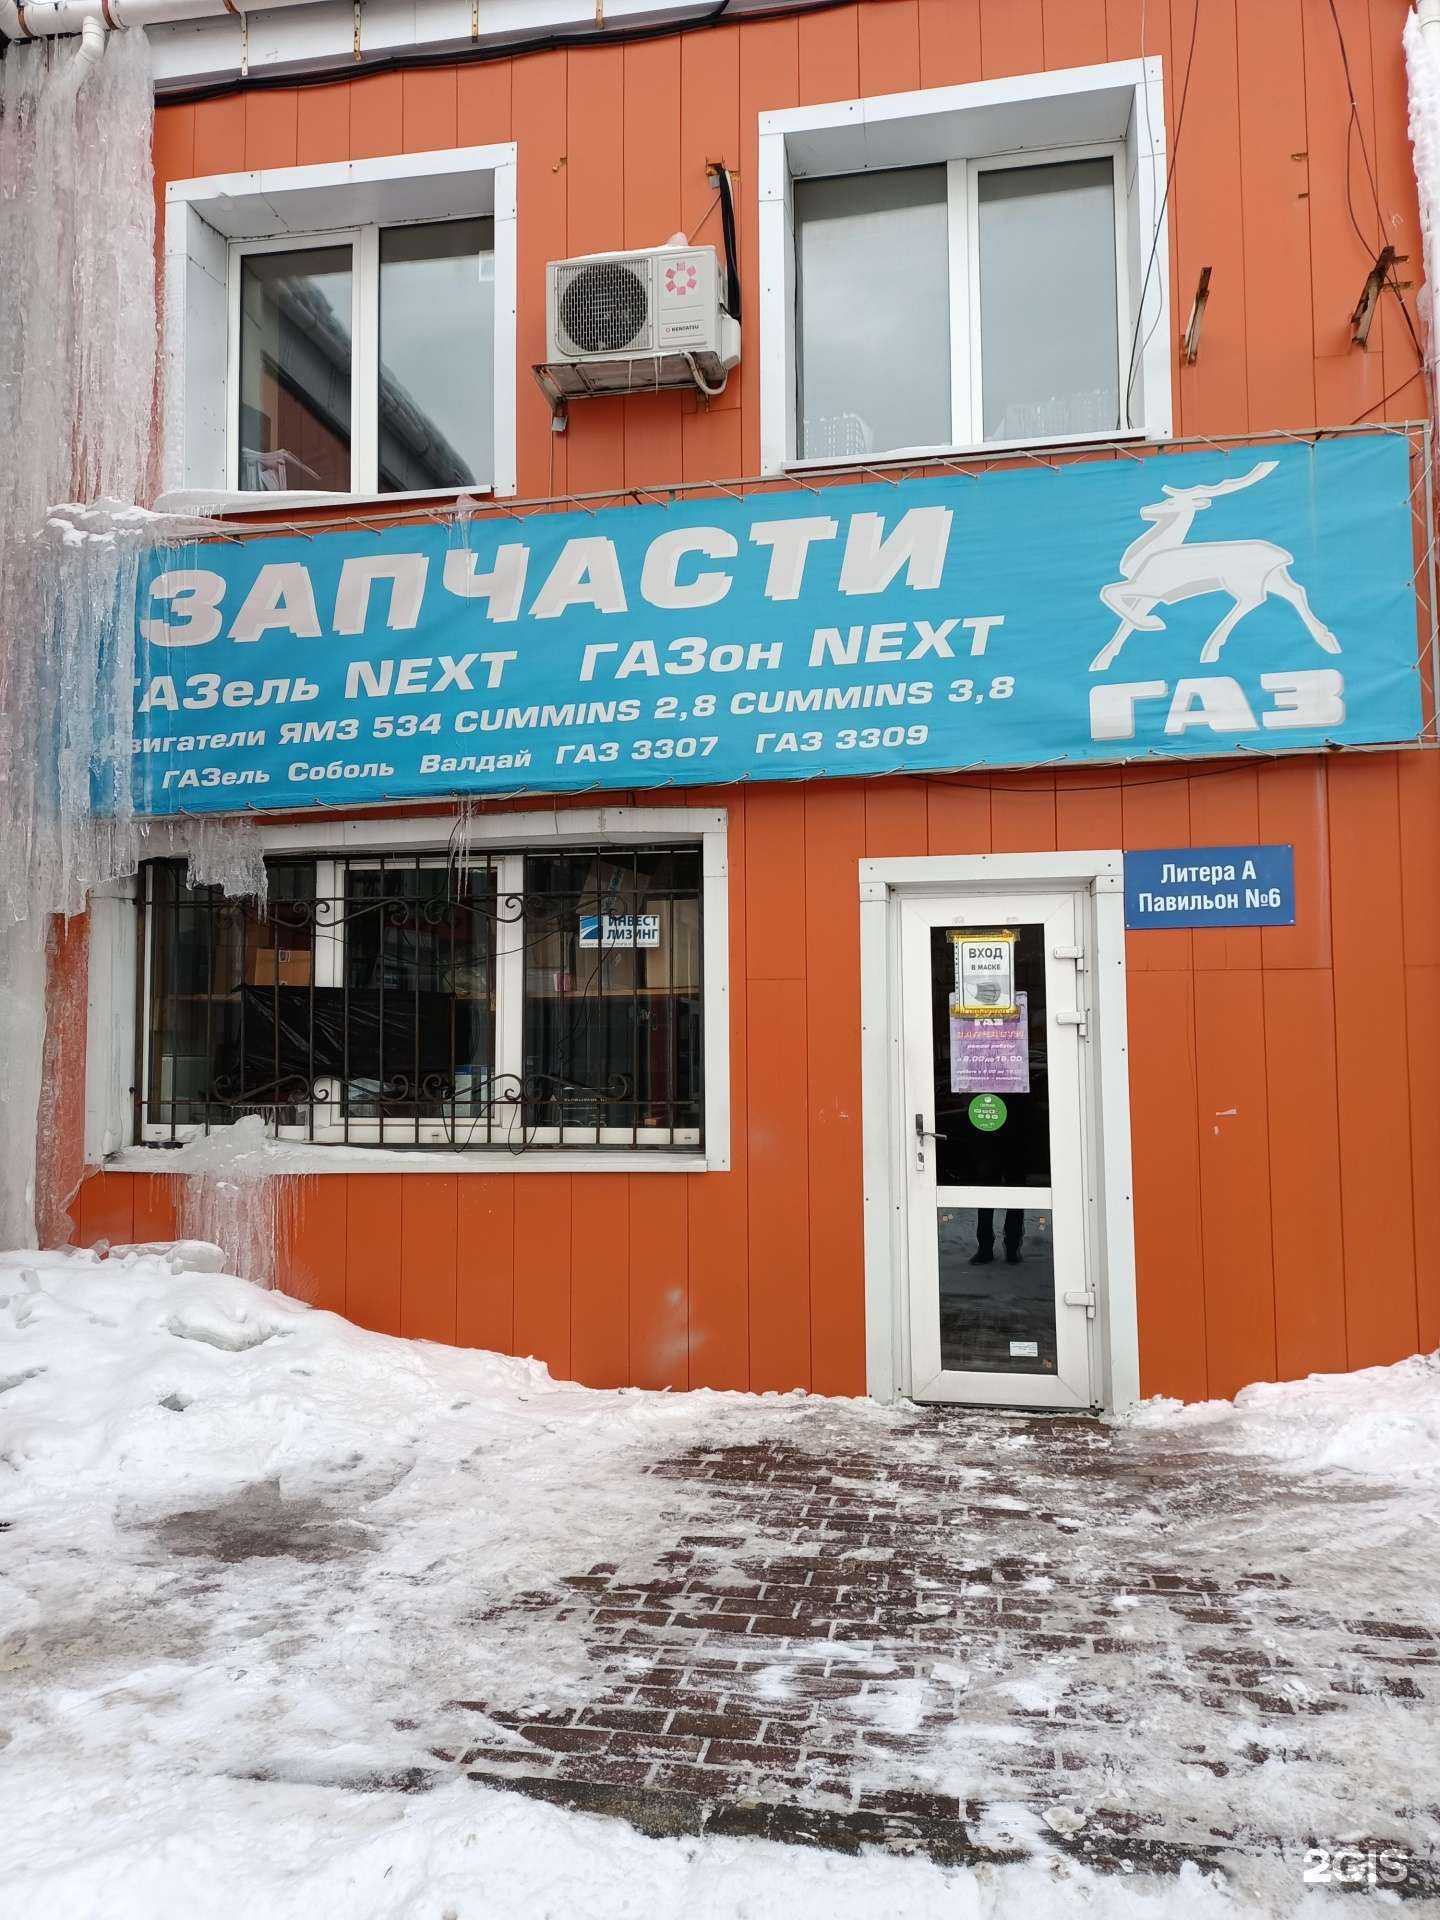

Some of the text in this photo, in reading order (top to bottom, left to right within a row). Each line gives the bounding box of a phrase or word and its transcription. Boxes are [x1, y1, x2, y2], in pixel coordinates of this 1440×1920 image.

[140, 505, 954, 647] ЗАПЧАСТИ
[345, 651, 517, 698] NEXT
[580, 637, 783, 681] ГАЗон
[809, 616, 1004, 666] NEXT
[131, 676, 1015, 755] вигатели ЯМЗ 534 CUMMINS 2,8 CUMMINS 3,8
[1089, 668, 1345, 740] ГАЗ
[163, 725, 928, 788] ГАЗель Соболь Валдай ГАЗ 3307 ГАЗ 3309
[1161, 861, 1256, 885] Литера А
[1139, 888, 1280, 912] Павильон №6
[607, 928, 658, 940] ЛИЗИНГ
[968, 947, 1003, 960] ВХОД
[977, 963, 1001, 971] МАСКЕ
